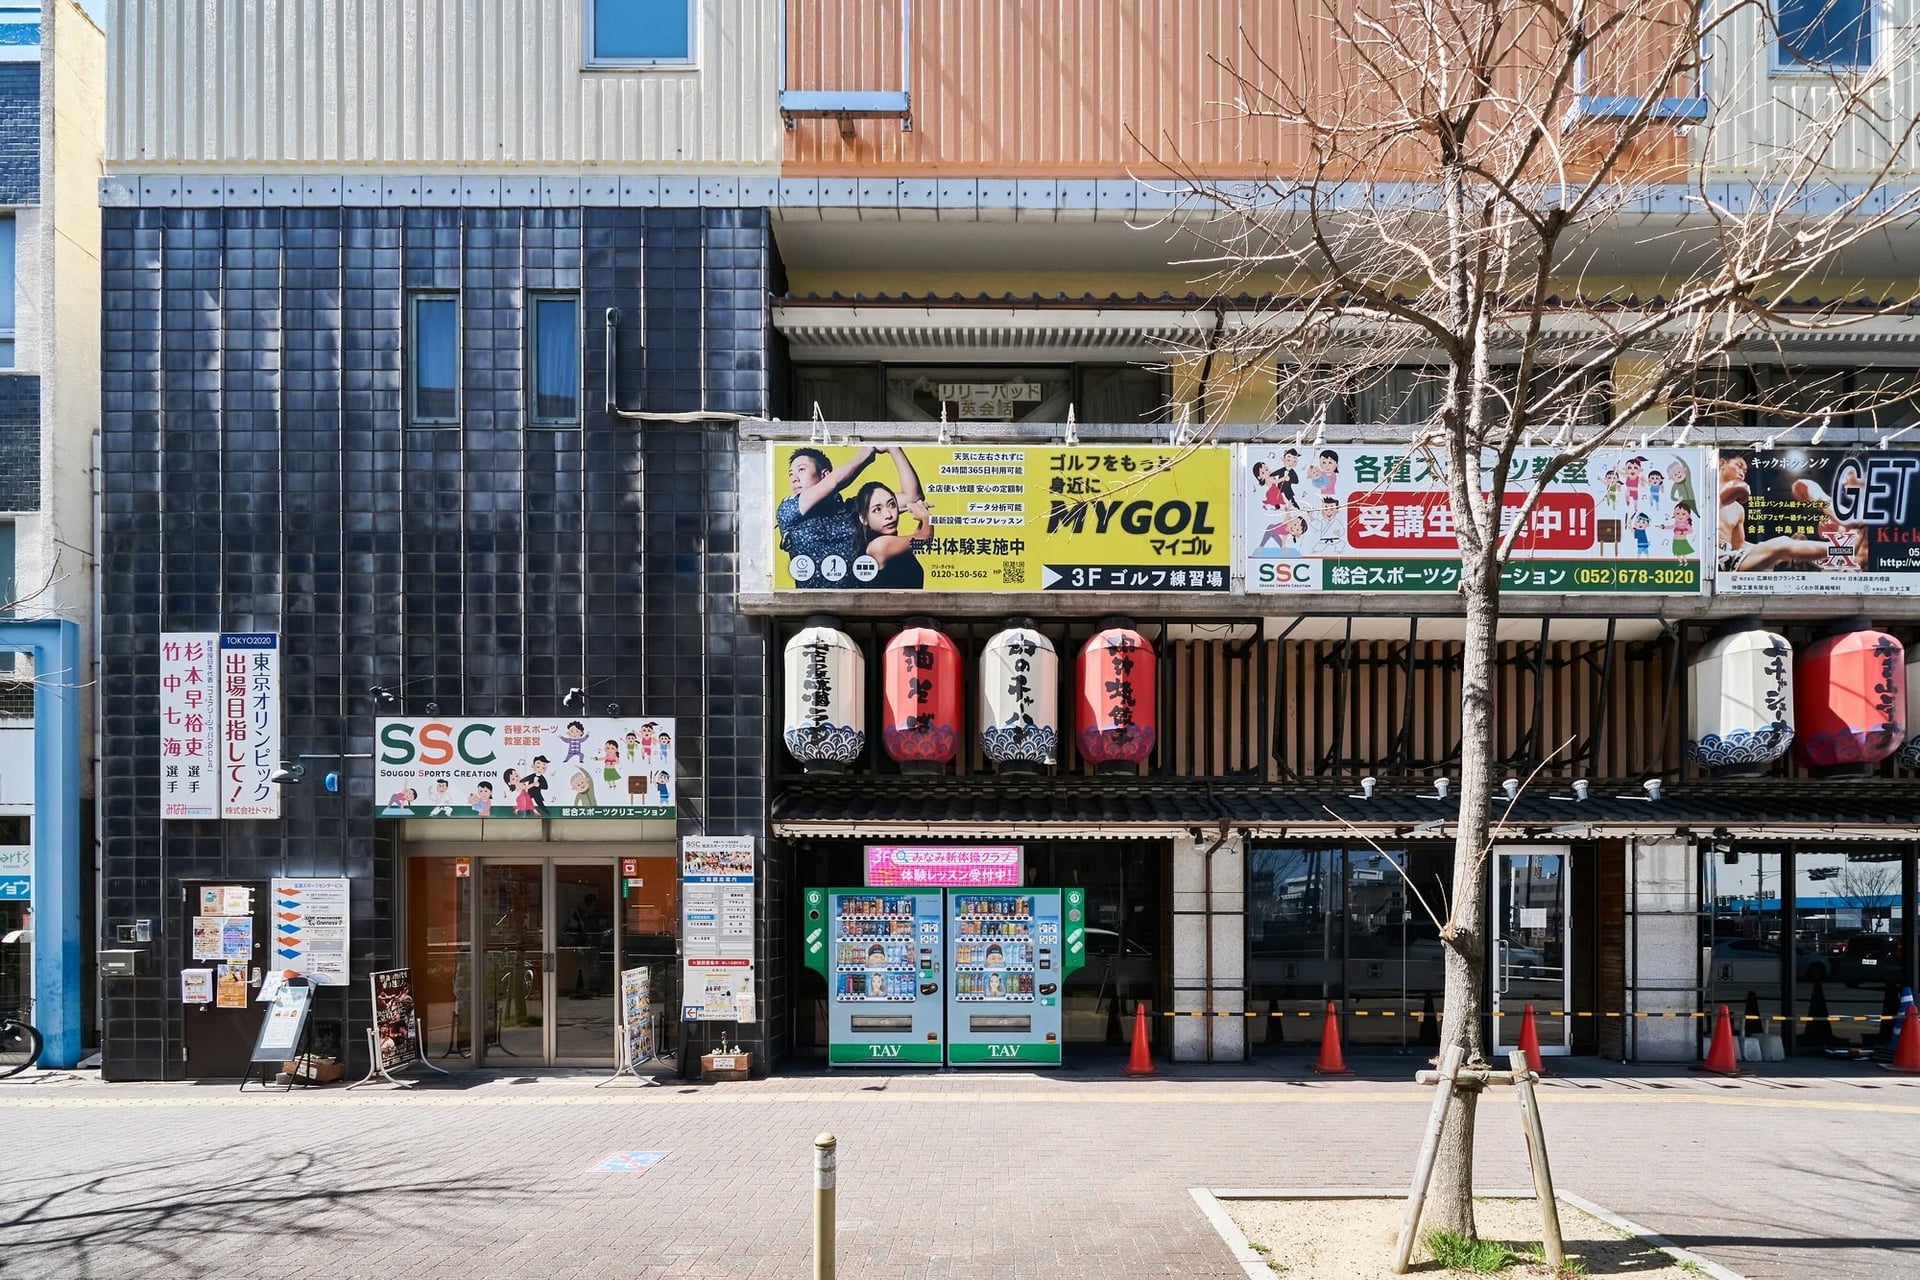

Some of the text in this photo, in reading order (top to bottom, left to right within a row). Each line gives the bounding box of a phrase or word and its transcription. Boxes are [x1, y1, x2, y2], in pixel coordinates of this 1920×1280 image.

[960, 400, 1012, 417] 英会話
[953, 452, 1024, 461] 天気に左右されずに
[1050, 453, 1172, 472] ゴルフをもっと
[1750, 457, 1830, 469] キックボクシング
[940, 466, 1023, 475] 24時間365日利用可能
[927, 484, 1024, 493] 全店使い放題 安心の定額制
[1049, 476, 1102, 495] 身近に
[1832, 458, 1918, 525] GET
[969, 503, 1023, 512] データ分析可能
[930, 516, 1023, 525] 最新設備でゴルフレッスン
[1046, 500, 1216, 535] MYGOL
[909, 537, 1025, 556] 無料体験実施中
[1149, 536, 1213, 556] マイゴル
[931, 570, 988, 579] 0120-150-562
[1071, 568, 1223, 587] 3F ゴルフ練習場
[1259, 563, 1311, 583] SSC
[226, 636, 272, 645] TOKYO2020
[225, 653, 246, 803] 出場目指して!
[251, 652, 271, 802] 東京オリンピック
[503, 723, 559, 735] 各種スポーツ
[380, 723, 497, 765] SSC
[503, 736, 541, 747] 教室運営
[380, 769, 498, 778] SOUGOU SPORTS CREATION
[225, 806, 275, 815] 株式会社トマト
[562, 807, 668, 817] 総合スポーツクリエーション
[901, 868, 1013, 882] 体験レッスン受付中!
